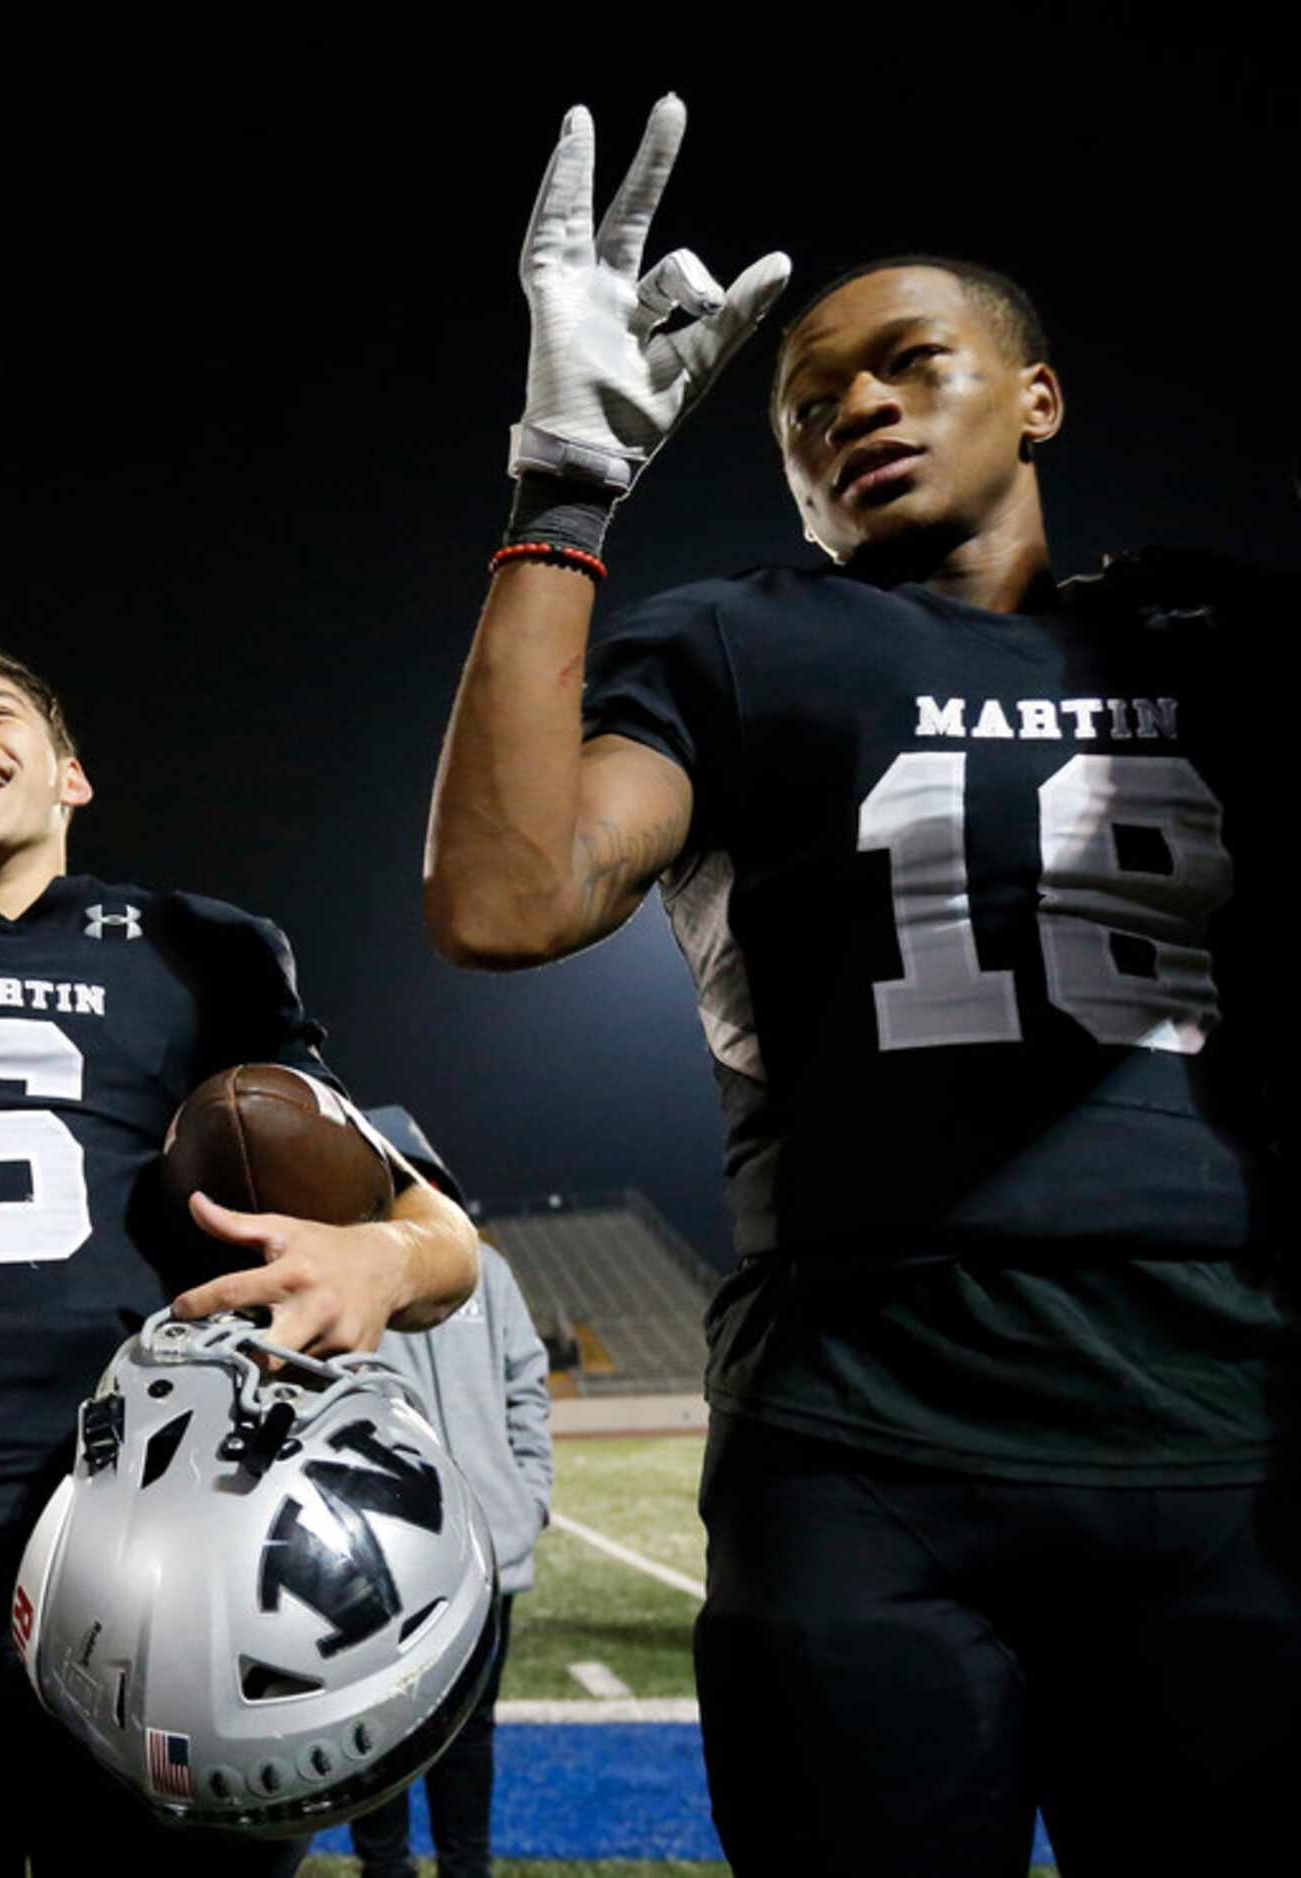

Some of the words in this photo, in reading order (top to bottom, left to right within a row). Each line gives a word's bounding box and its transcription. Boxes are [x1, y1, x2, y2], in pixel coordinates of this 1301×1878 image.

[914, 695, 1180, 740] MARTIN
[856, 751, 1235, 1056] 18
[256, 1418, 444, 1659] M
